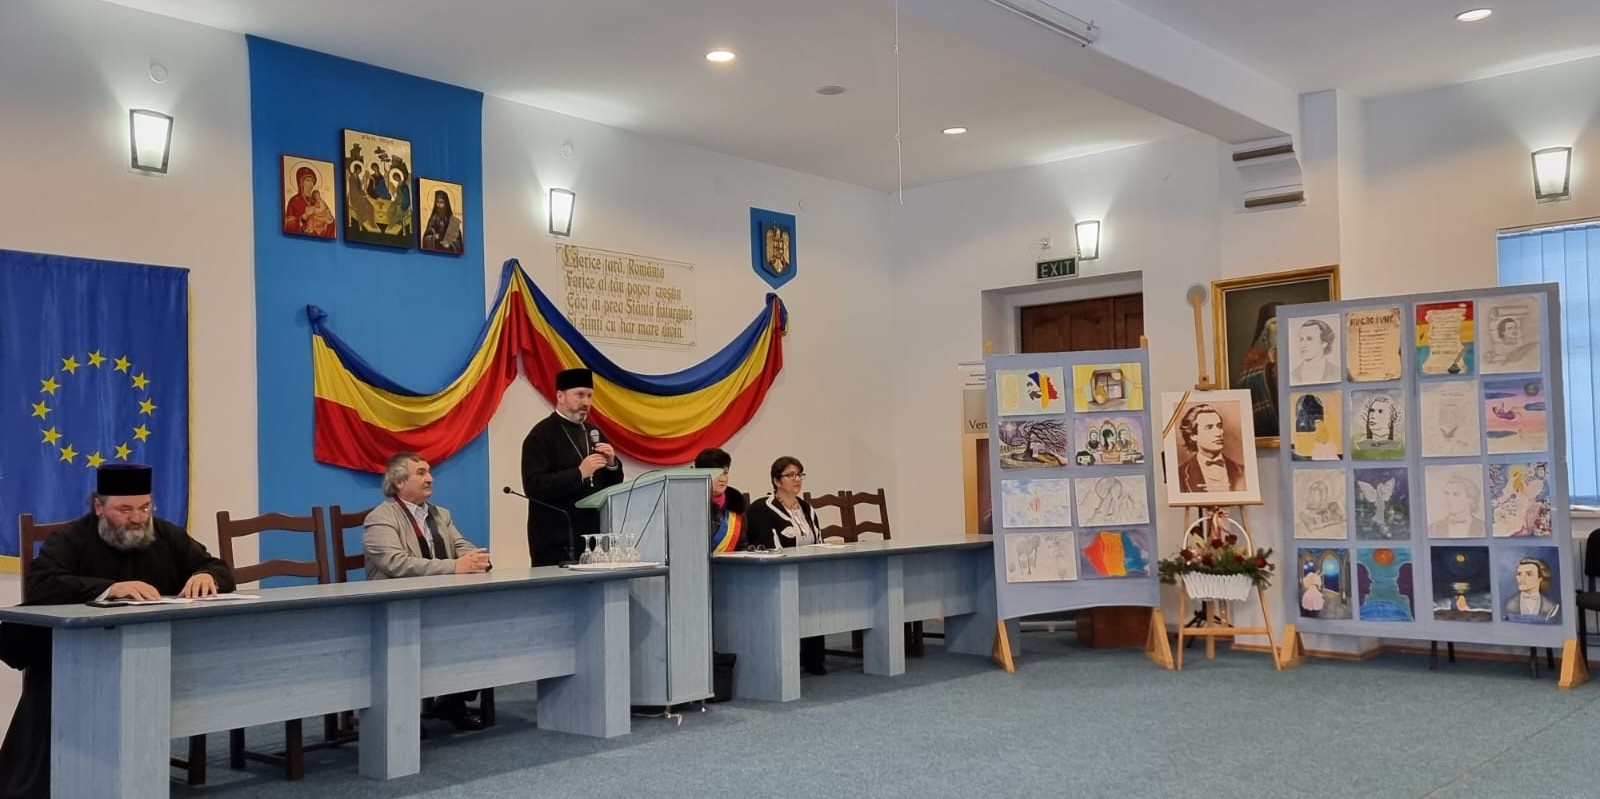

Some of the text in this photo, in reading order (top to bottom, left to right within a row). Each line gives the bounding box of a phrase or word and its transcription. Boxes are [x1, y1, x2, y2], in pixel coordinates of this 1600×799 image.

[1041, 260, 1072, 277] EXIT
[566, 270, 595, 289] Ferice
[598, 276, 607, 291] al
[627, 282, 650, 300] popor
[591, 295, 601, 311] ai
[604, 300, 624, 315] prea
[605, 320, 616, 332] cu
[620, 317, 635, 334] har
[638, 323, 660, 337] mare
[968, 419, 988, 430] Ven
